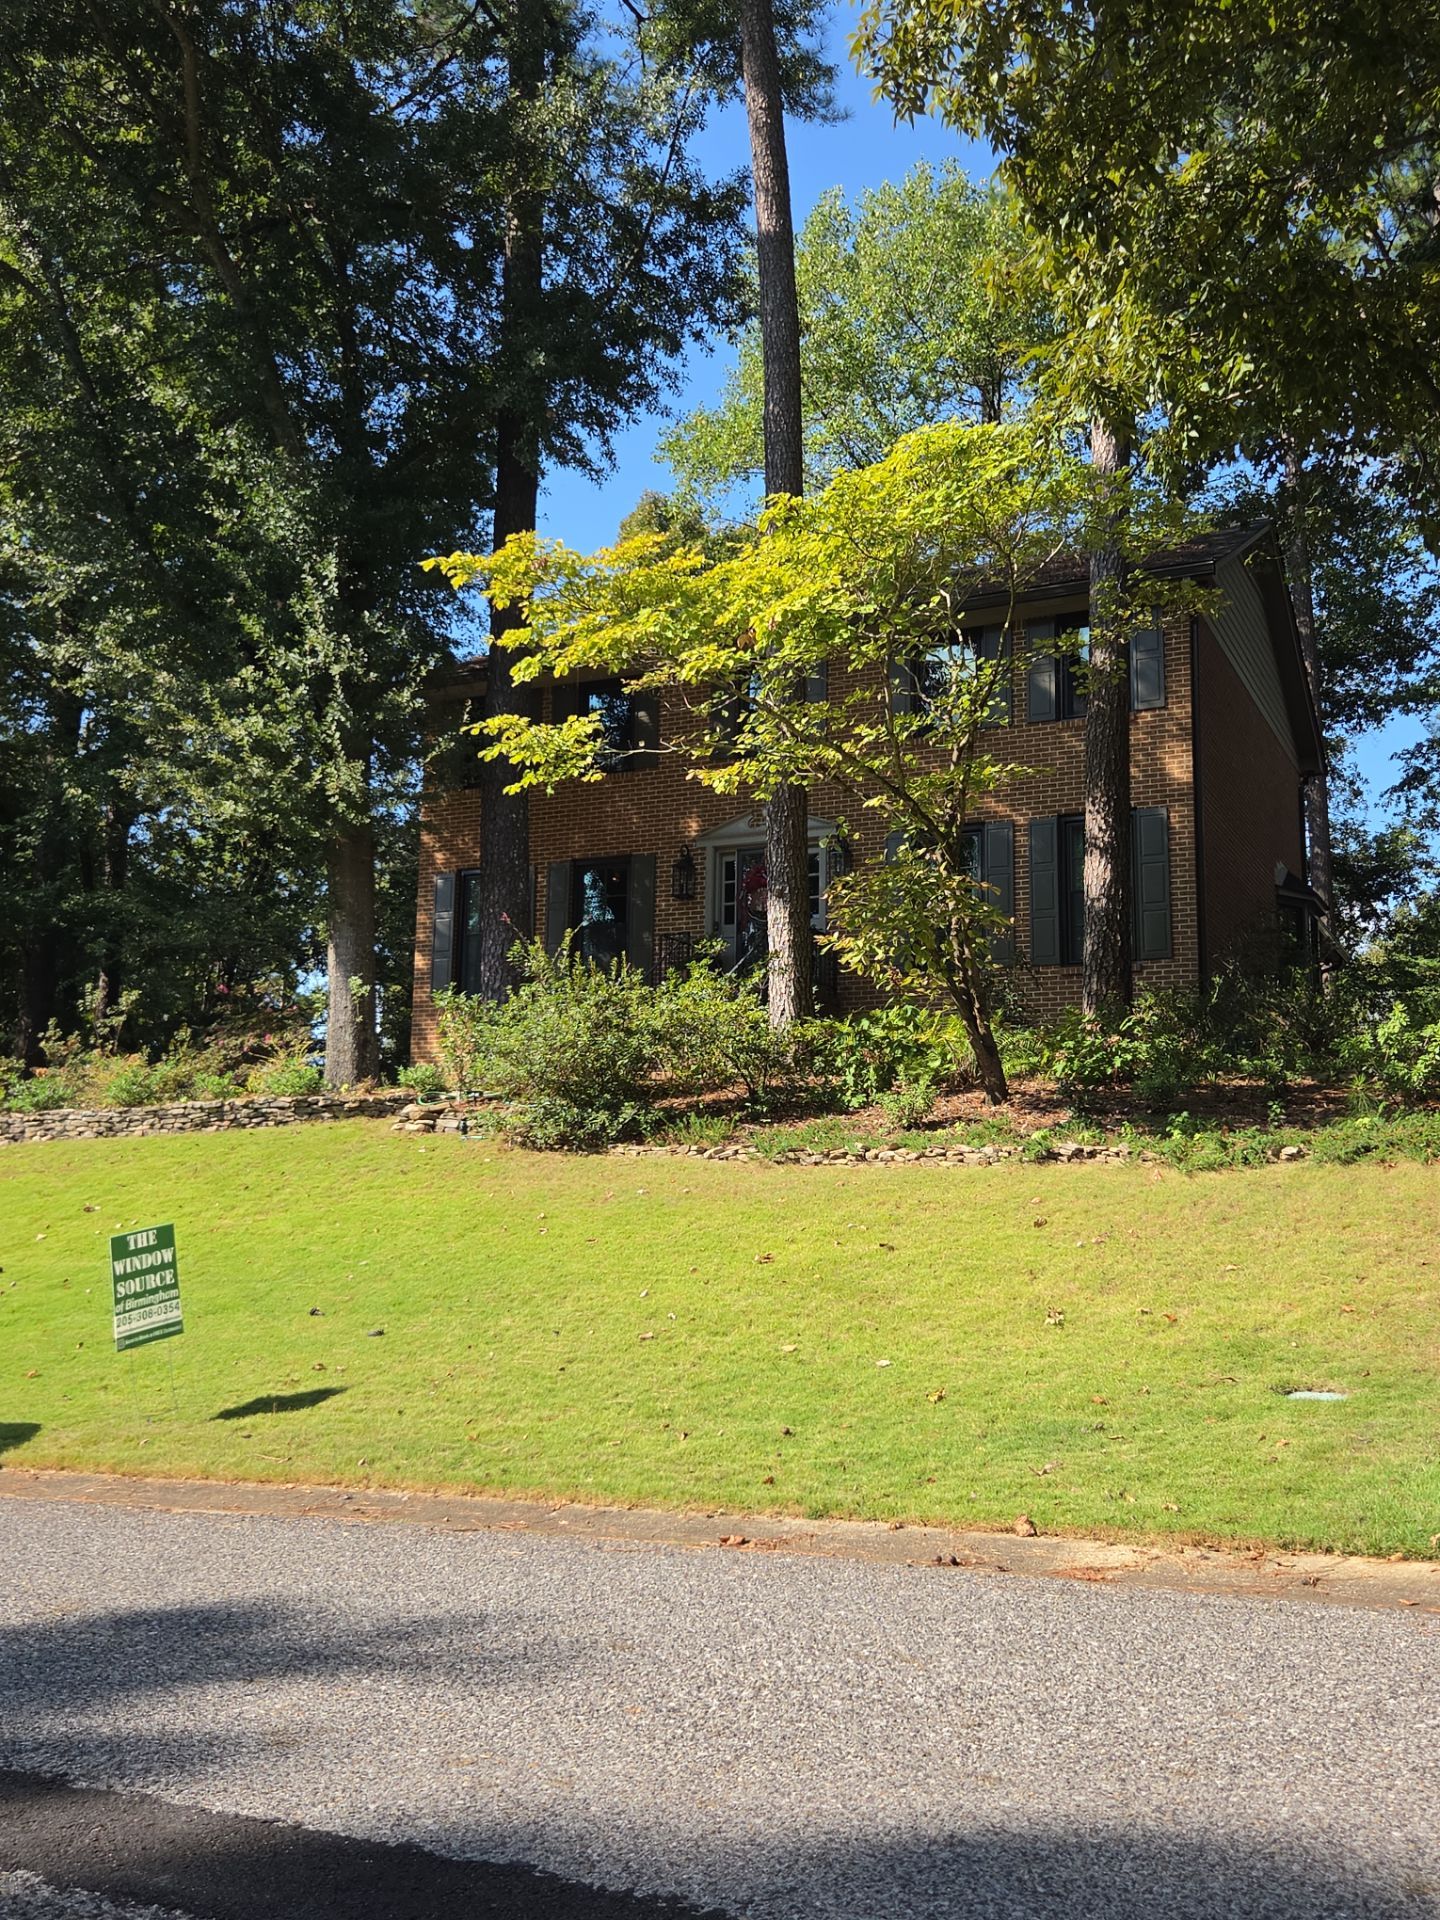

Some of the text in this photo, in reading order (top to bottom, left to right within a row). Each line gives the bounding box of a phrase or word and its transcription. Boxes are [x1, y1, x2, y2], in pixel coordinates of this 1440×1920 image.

[127, 1230, 158, 1250] THE
[113, 1247, 175, 1276] WINDOW
[116, 1269, 175, 1298] SOURCE
[115, 1289, 179, 1314] of Birmingham
